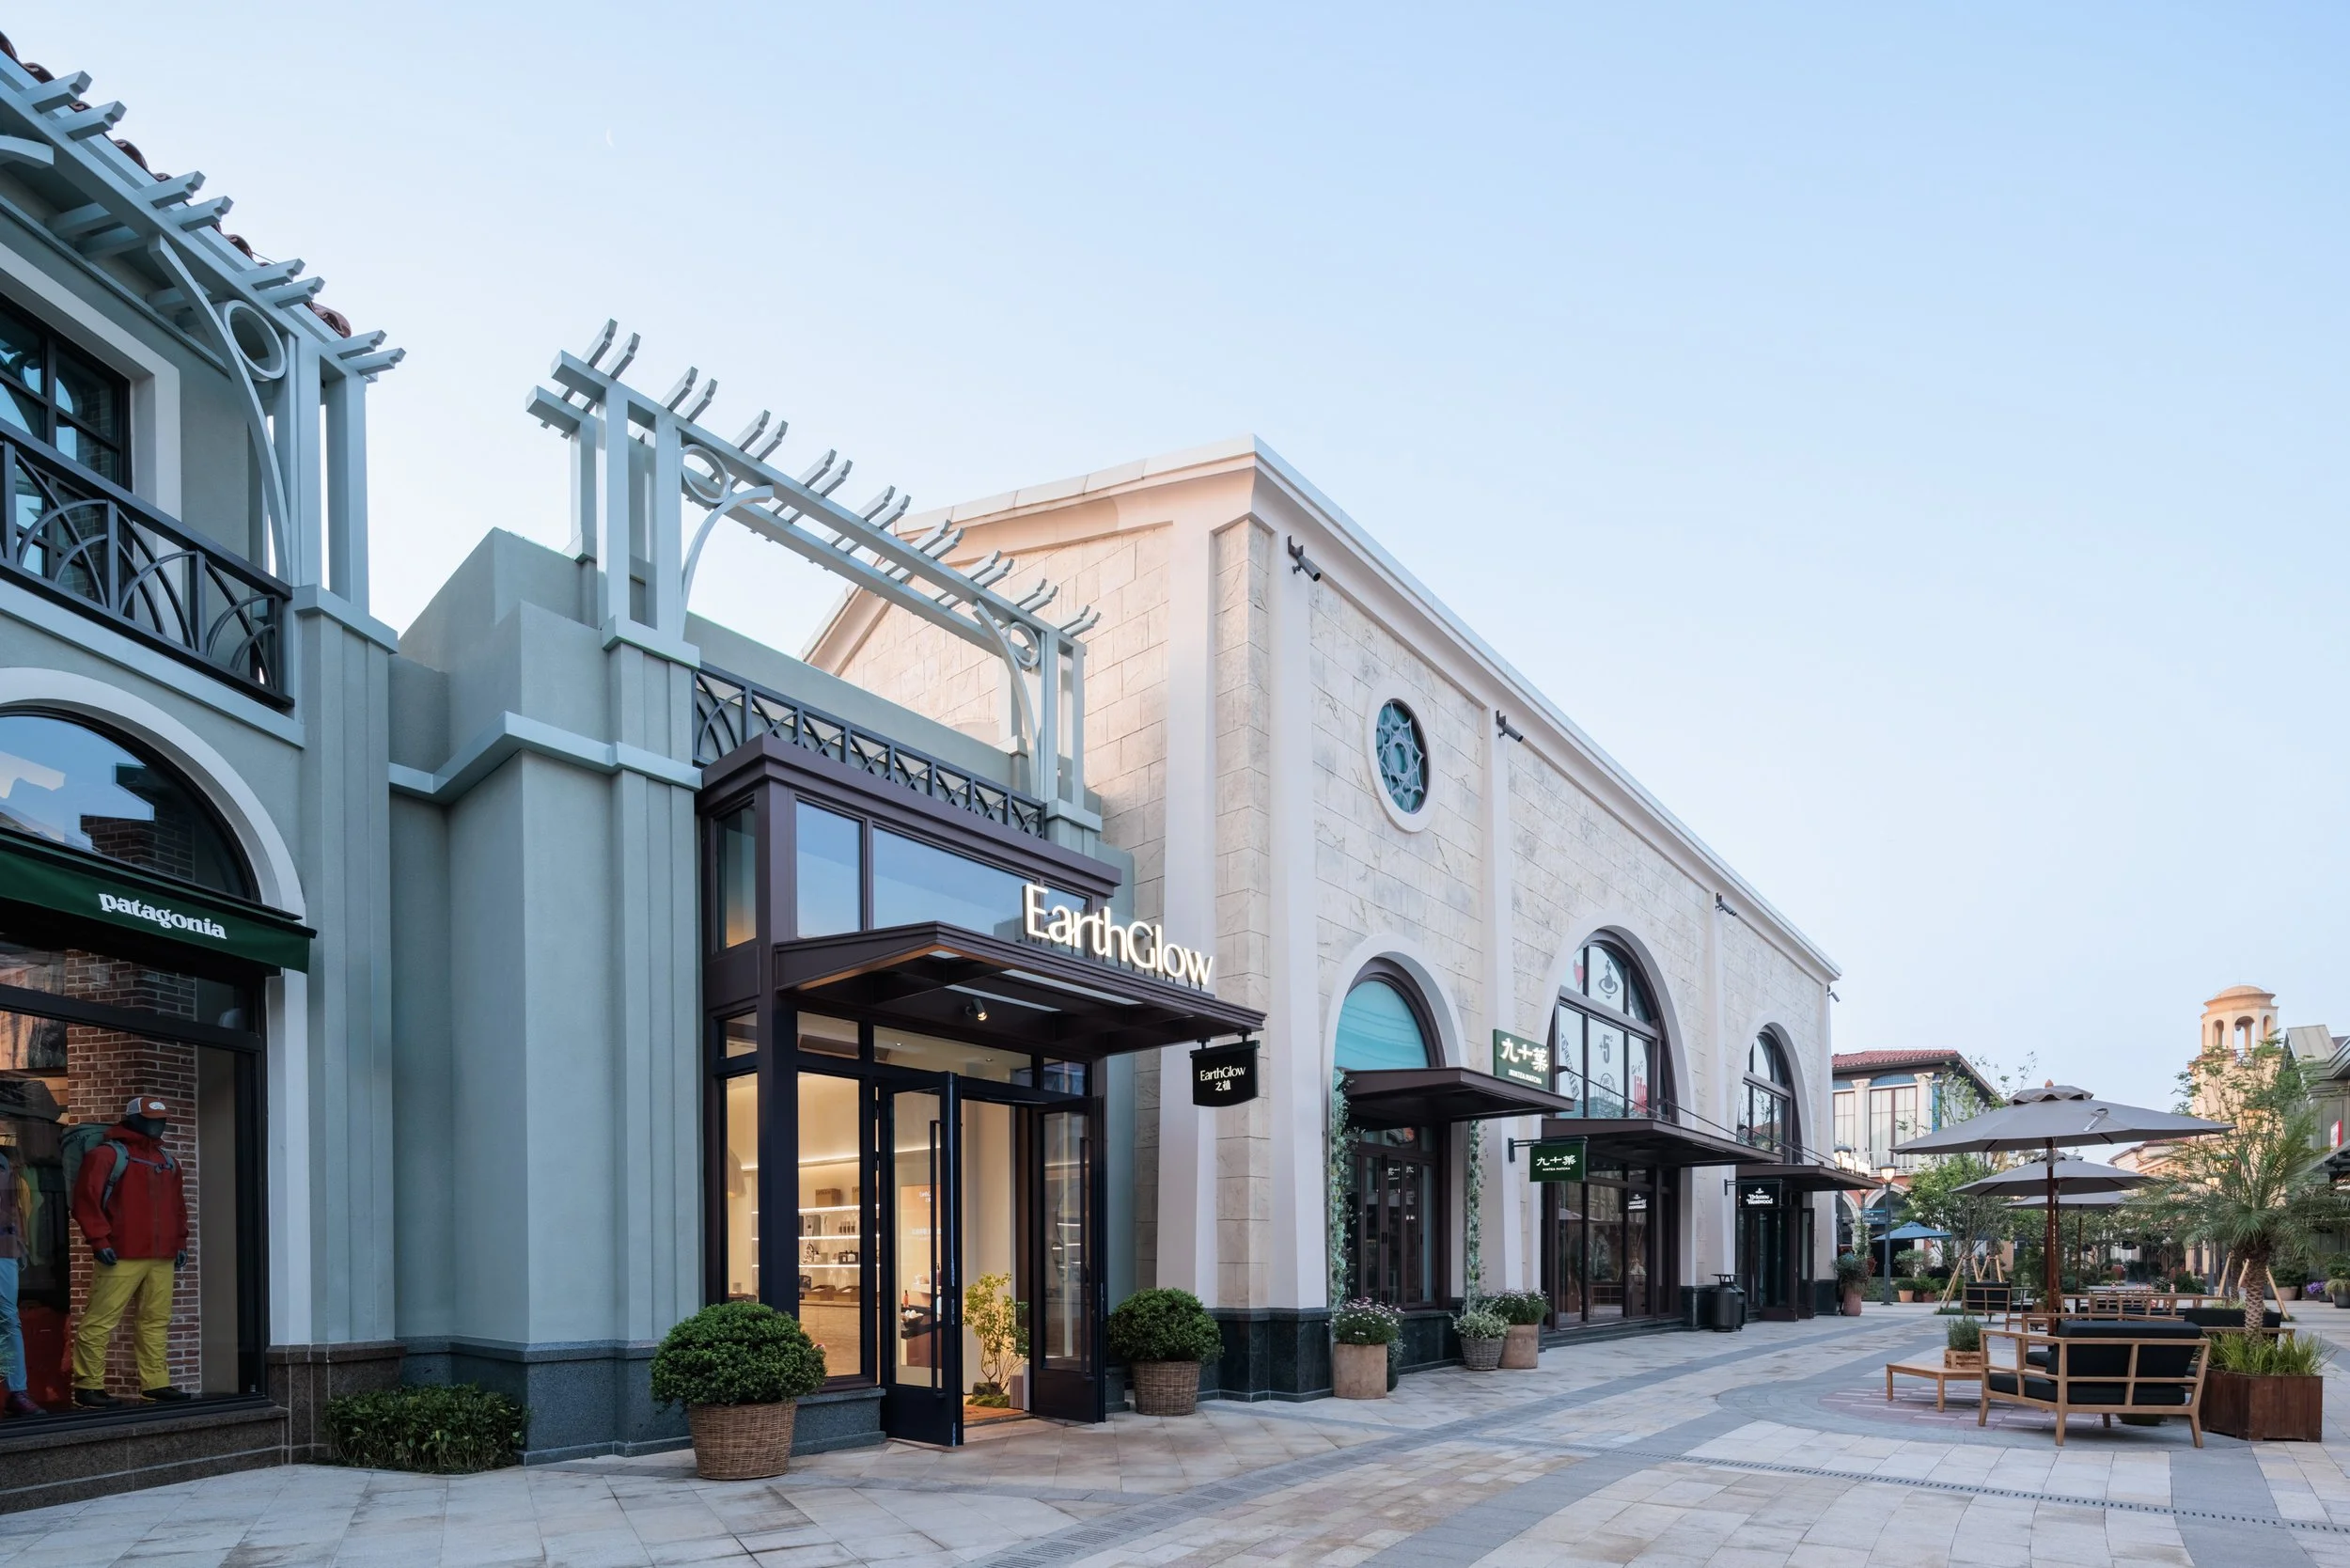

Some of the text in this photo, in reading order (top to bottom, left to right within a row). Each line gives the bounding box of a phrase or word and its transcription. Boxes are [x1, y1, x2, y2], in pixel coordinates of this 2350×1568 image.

[99, 893, 227, 939] patagonia
[1023, 883, 1214, 985] EarthGlow
[1200, 1066, 1246, 1081] EarthGlow
